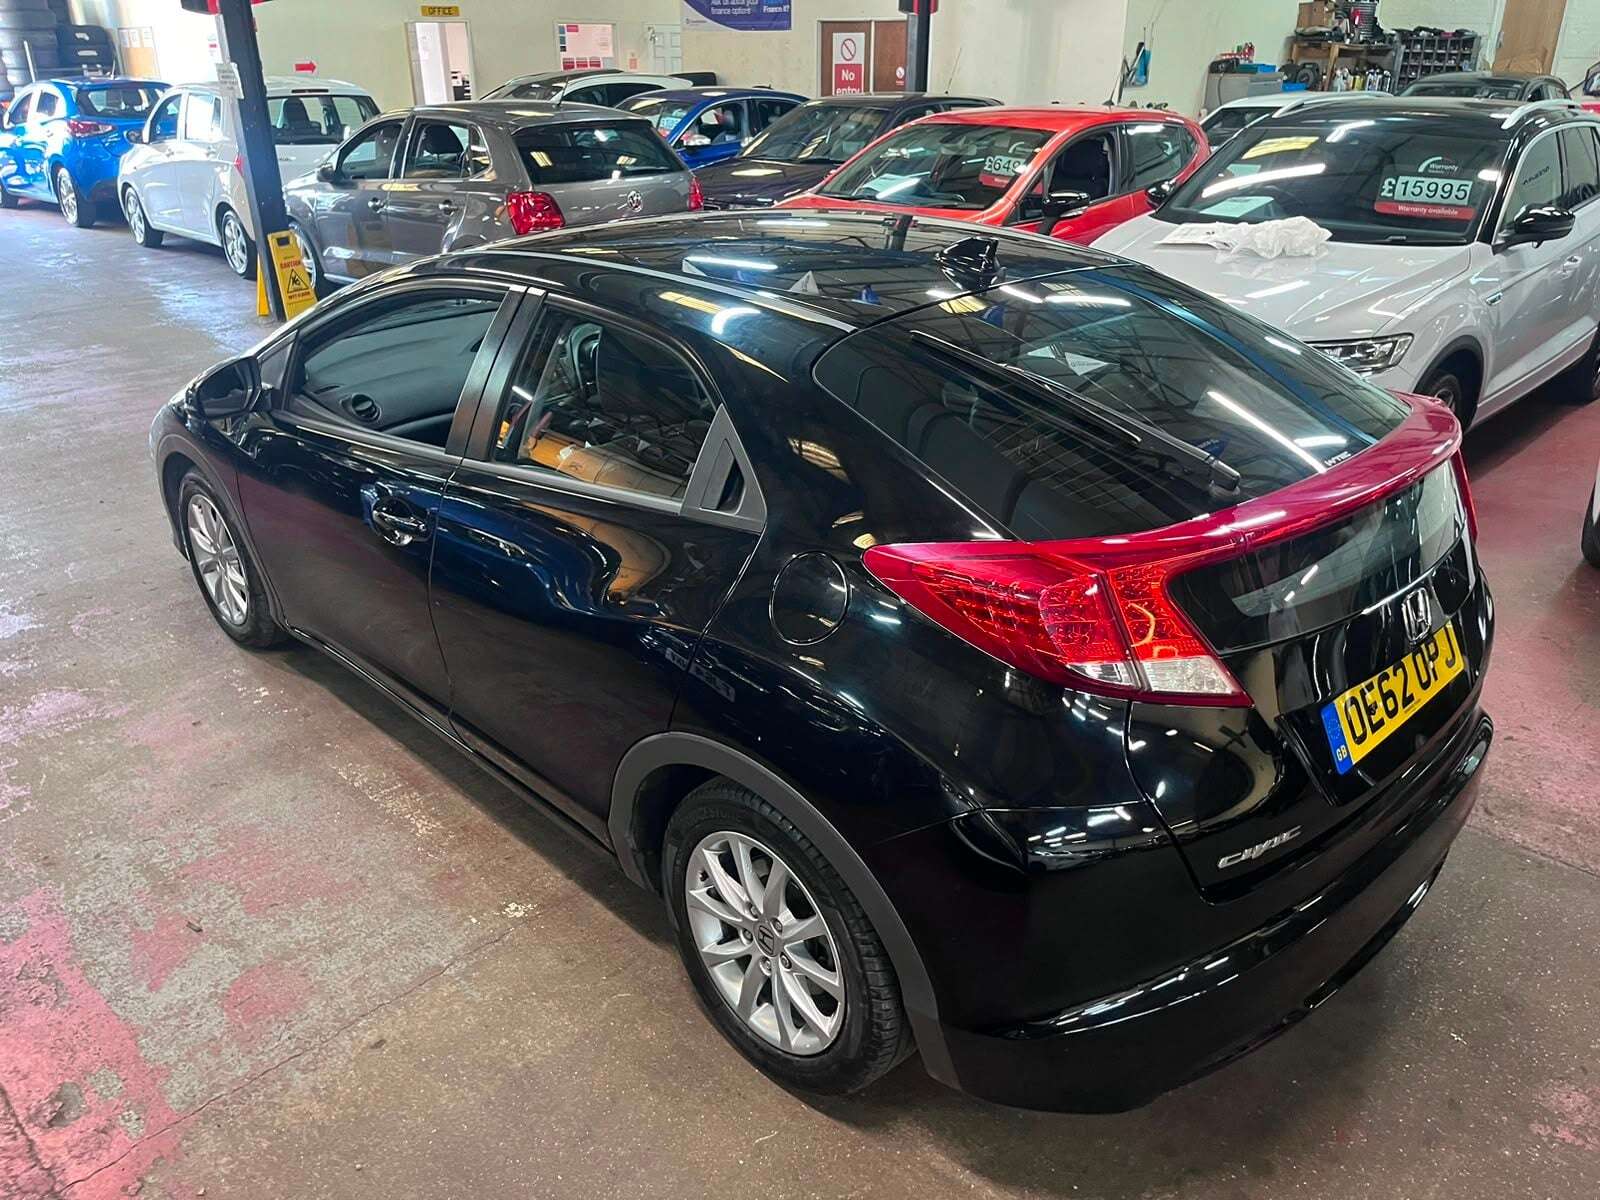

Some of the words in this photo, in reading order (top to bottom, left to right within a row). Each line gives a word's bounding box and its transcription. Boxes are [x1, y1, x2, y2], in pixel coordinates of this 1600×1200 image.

[428, 6, 454, 16] OFFICE
[841, 69, 855, 81] No
[1381, 177, 1470, 201] £15995
[1398, 205, 1427, 215] Warranty
[1336, 744, 1348, 761] GB
